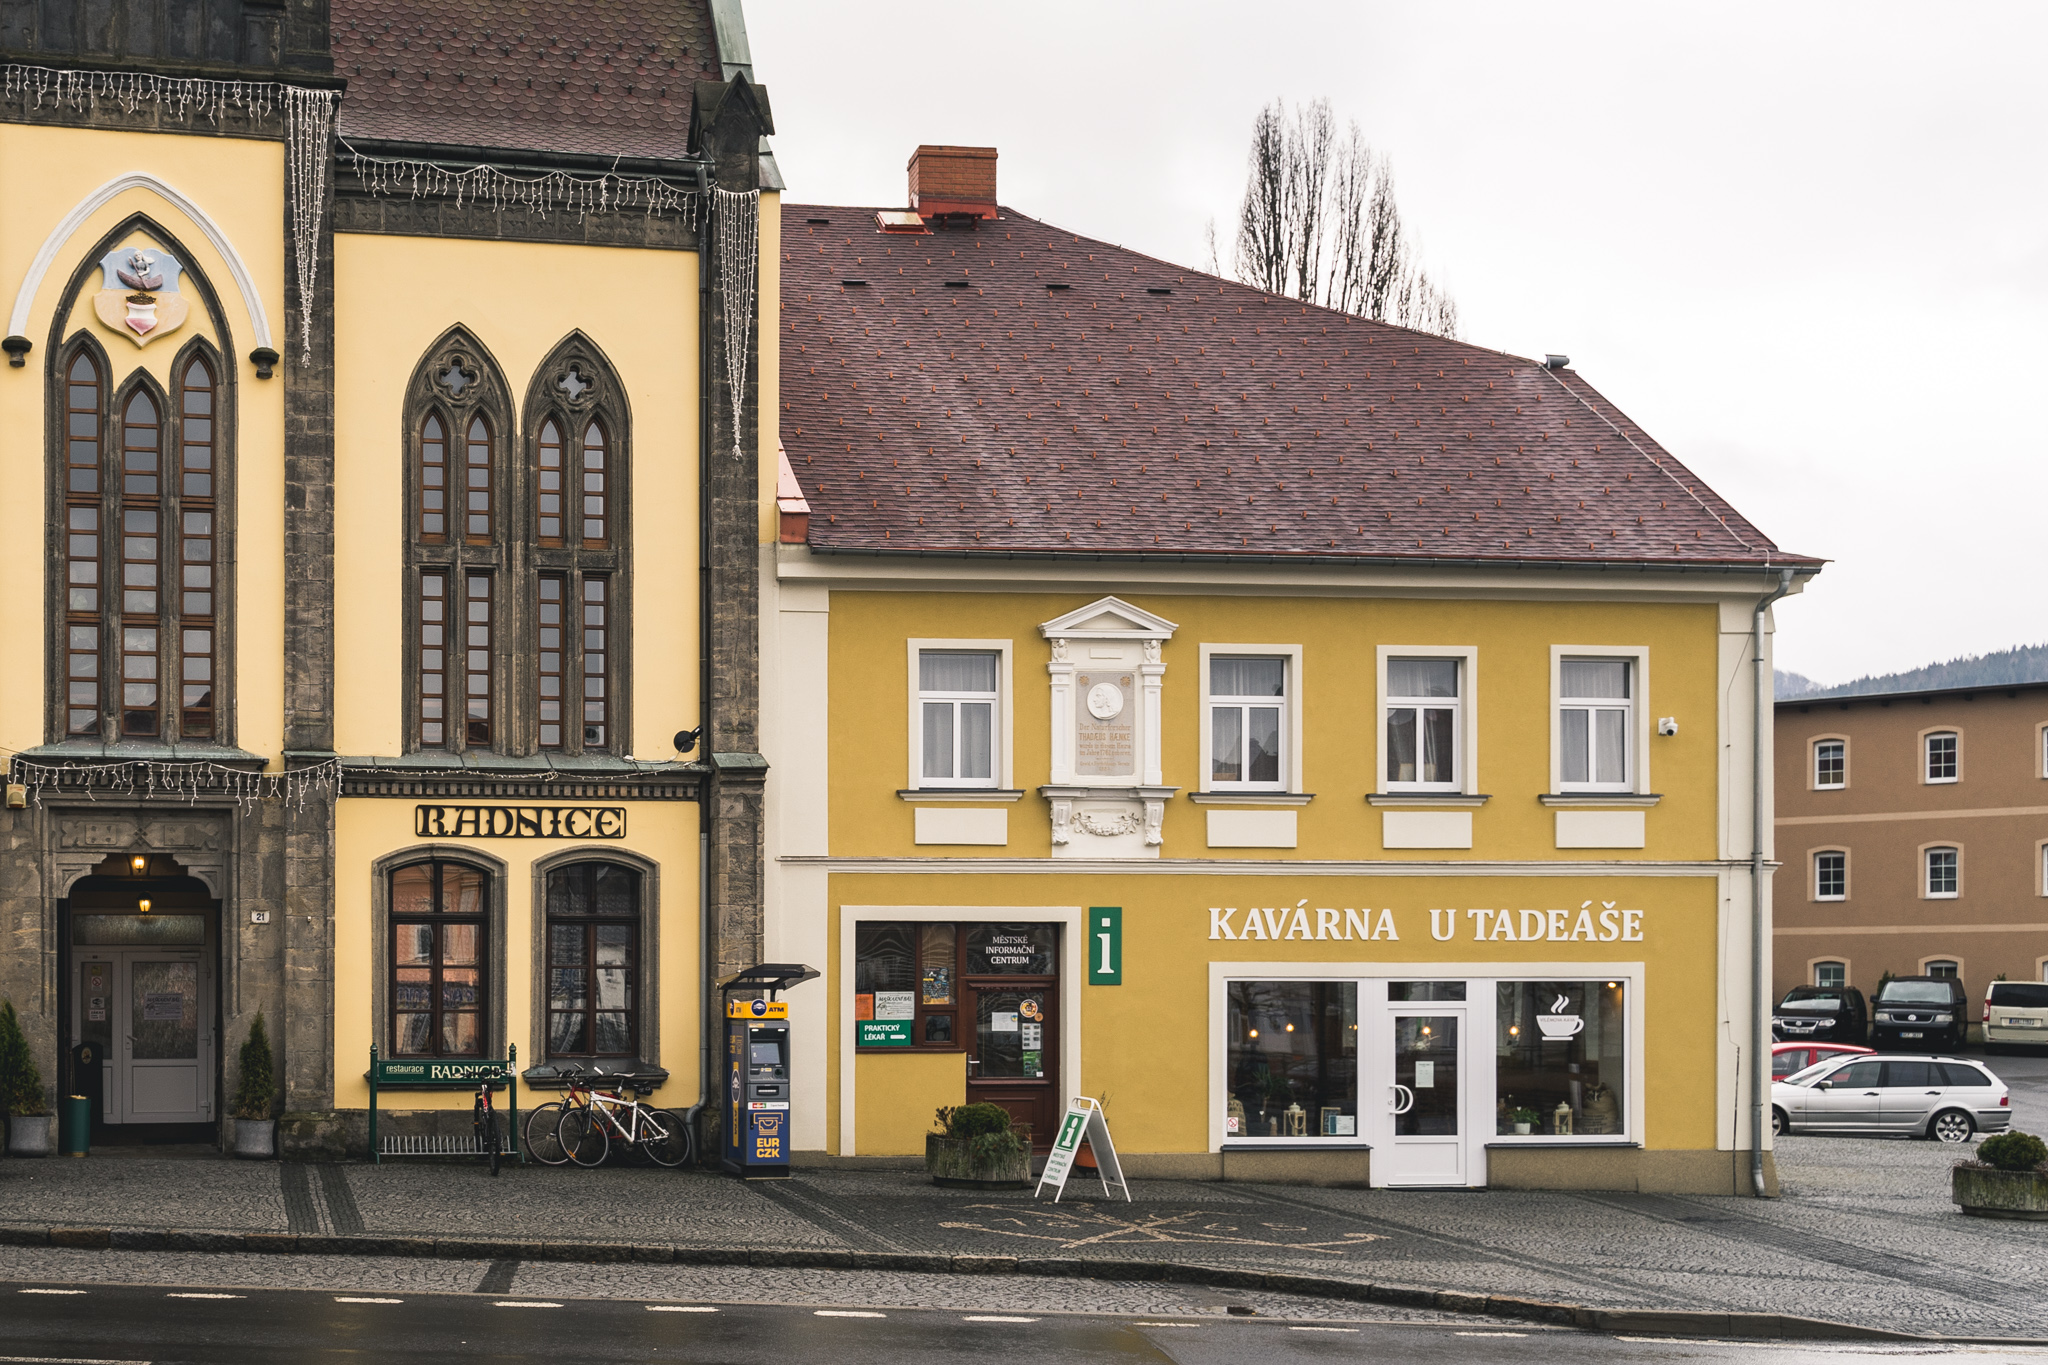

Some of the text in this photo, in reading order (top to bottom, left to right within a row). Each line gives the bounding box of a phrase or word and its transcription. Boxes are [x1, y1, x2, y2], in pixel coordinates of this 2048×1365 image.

[418, 806, 622, 837] RADNICE
[256, 912, 265, 921] 21
[1207, 899, 1644, 942] KAVÁRNA U TADEÁŠE
[992, 934, 1029, 944] MĚSTSKÉ
[985, 944, 1036, 954] INFORMAČNÍ
[990, 956, 1030, 965] CENTRUM
[864, 1023, 901, 1032] PRAKTICKÝ
[864, 1032, 886, 1041] LÉKAŘ
[386, 1064, 424, 1073] restaurace
[756, 1137, 780, 1148] EUR
[756, 1148, 780, 1158] CZK
